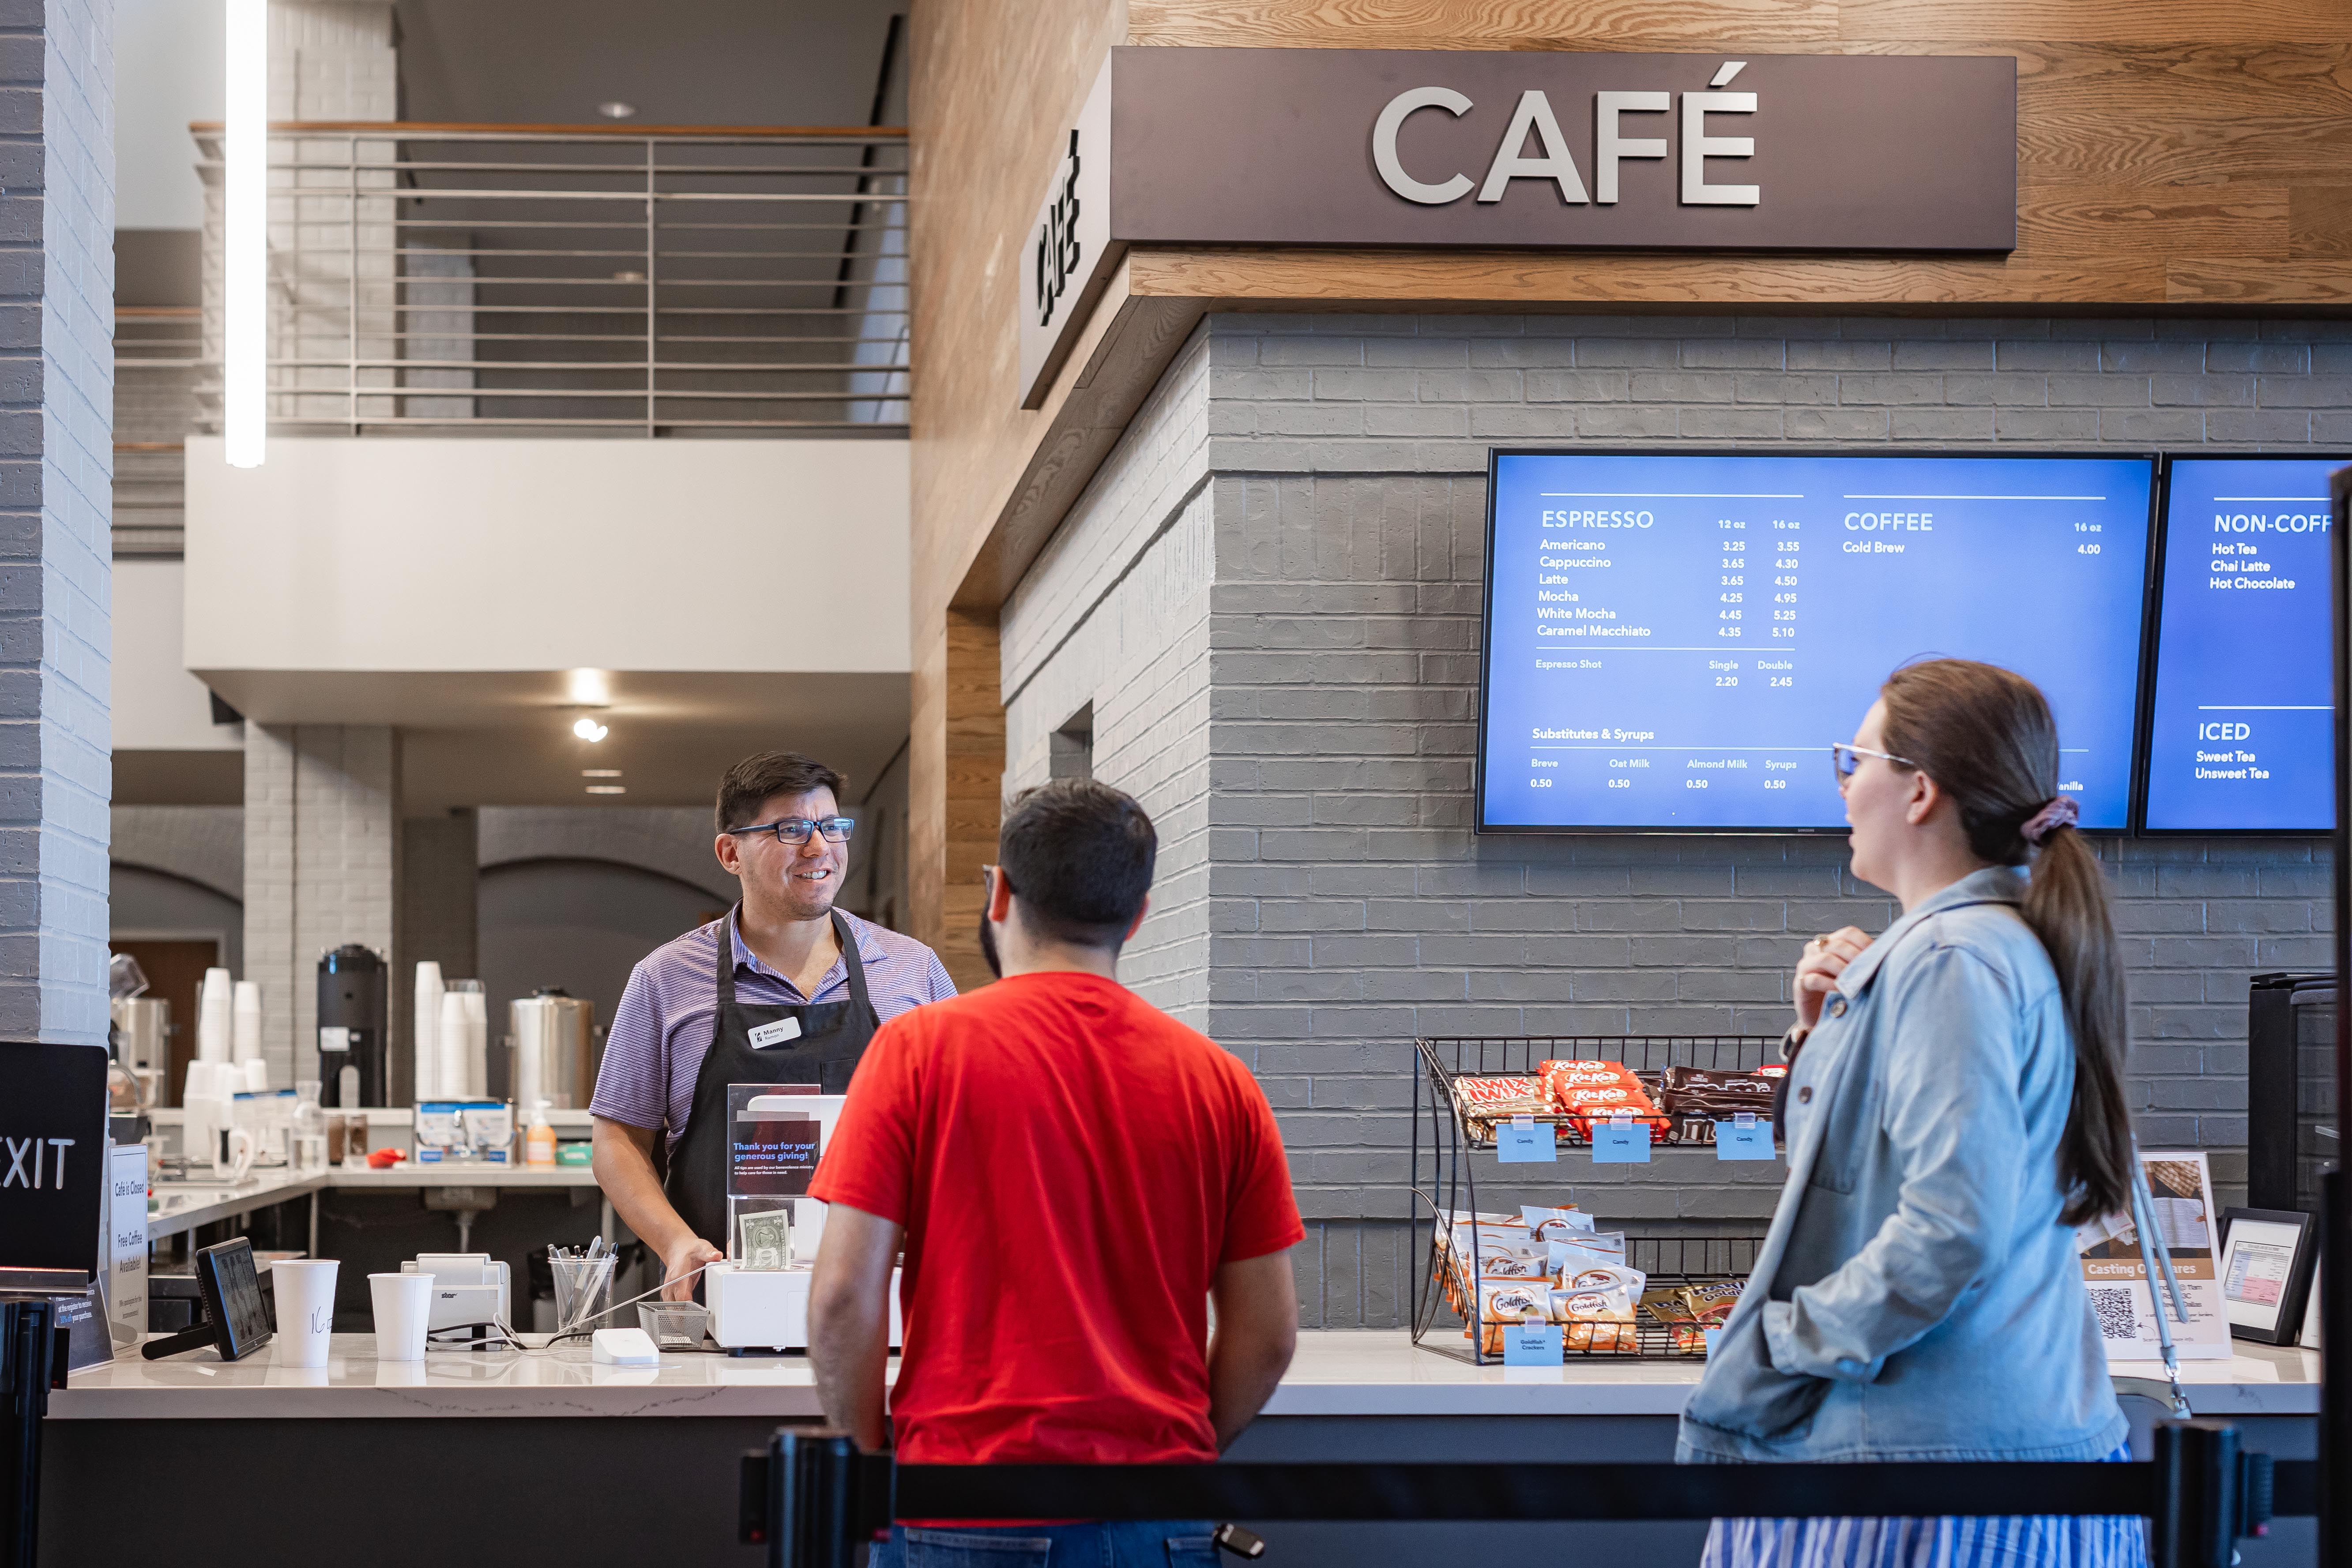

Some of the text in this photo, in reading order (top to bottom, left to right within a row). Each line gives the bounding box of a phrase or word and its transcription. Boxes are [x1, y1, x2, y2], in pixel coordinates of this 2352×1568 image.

[1372, 61, 1761, 205] CAFÉ
[1542, 510, 1654, 529] ESPRESSO
[1718, 519, 1731, 529] 12
[1772, 520, 1786, 529] 16
[1844, 512, 1933, 531] COFFEE
[2074, 522, 2088, 532] 16
[1539, 538, 1800, 552] Americano 3.25 3.55
[1843, 541, 2101, 554] Cold Brew 4.00
[2212, 542, 2257, 555] Hot Tea
[1539, 556, 1799, 570] Cappuccino 3.65 4.30
[2211, 560, 2271, 572] Chai Latte
[1539, 573, 1798, 586] Latte 3.65 4.50
[2210, 576, 2296, 589] Hot Chocolate
[1539, 590, 1797, 603] Mocha 4.25 4.95
[1536, 607, 1796, 620] White Mocha 4.45 5.25
[1537, 624, 1795, 637] Caramel Macchiato 4.35 5.10
[1535, 659, 1793, 672] Espresso Shot Single Double
[1716, 676, 1792, 687] 2.20 2.45
[1532, 727, 1654, 742] Substitutes & Syrups
[2199, 722, 2250, 741] ICED
[1531, 758, 1558, 767] Breve
[2196, 750, 2256, 762] Sweet Tea
[1609, 759, 1650, 768] Oat Milk
[1687, 759, 1748, 769] Almond Milk
[1765, 760, 1797, 771] Syrups
[2195, 767, 2269, 779] Unsweet Tea
[1530, 778, 1552, 788] 0.50
[1608, 779, 1630, 788] 0.50
[1686, 779, 1708, 789] 0.50
[1764, 779, 1786, 789] 0.50
[2057, 781, 2083, 791] anilla
[763, 1027, 783, 1035] Manny
[1464, 1077, 1534, 1090] TWIX
[1460, 1087, 1532, 1103] TWIX
[733, 1142, 760, 1151] Thank
[762, 1143, 779, 1152] you
[794, 1143, 815, 1151] your
[0, 1136, 75, 1190] XIT
[734, 1152, 808, 1162] generous giving!
[115, 1179, 145, 1197] Café is Closed
[118, 1230, 143, 1248] Free Coffee
[119, 1256, 141, 1274] Available!
[2088, 1263, 2197, 1277] Casting Or ares
[1572, 1300, 1608, 1312] Goldfish
